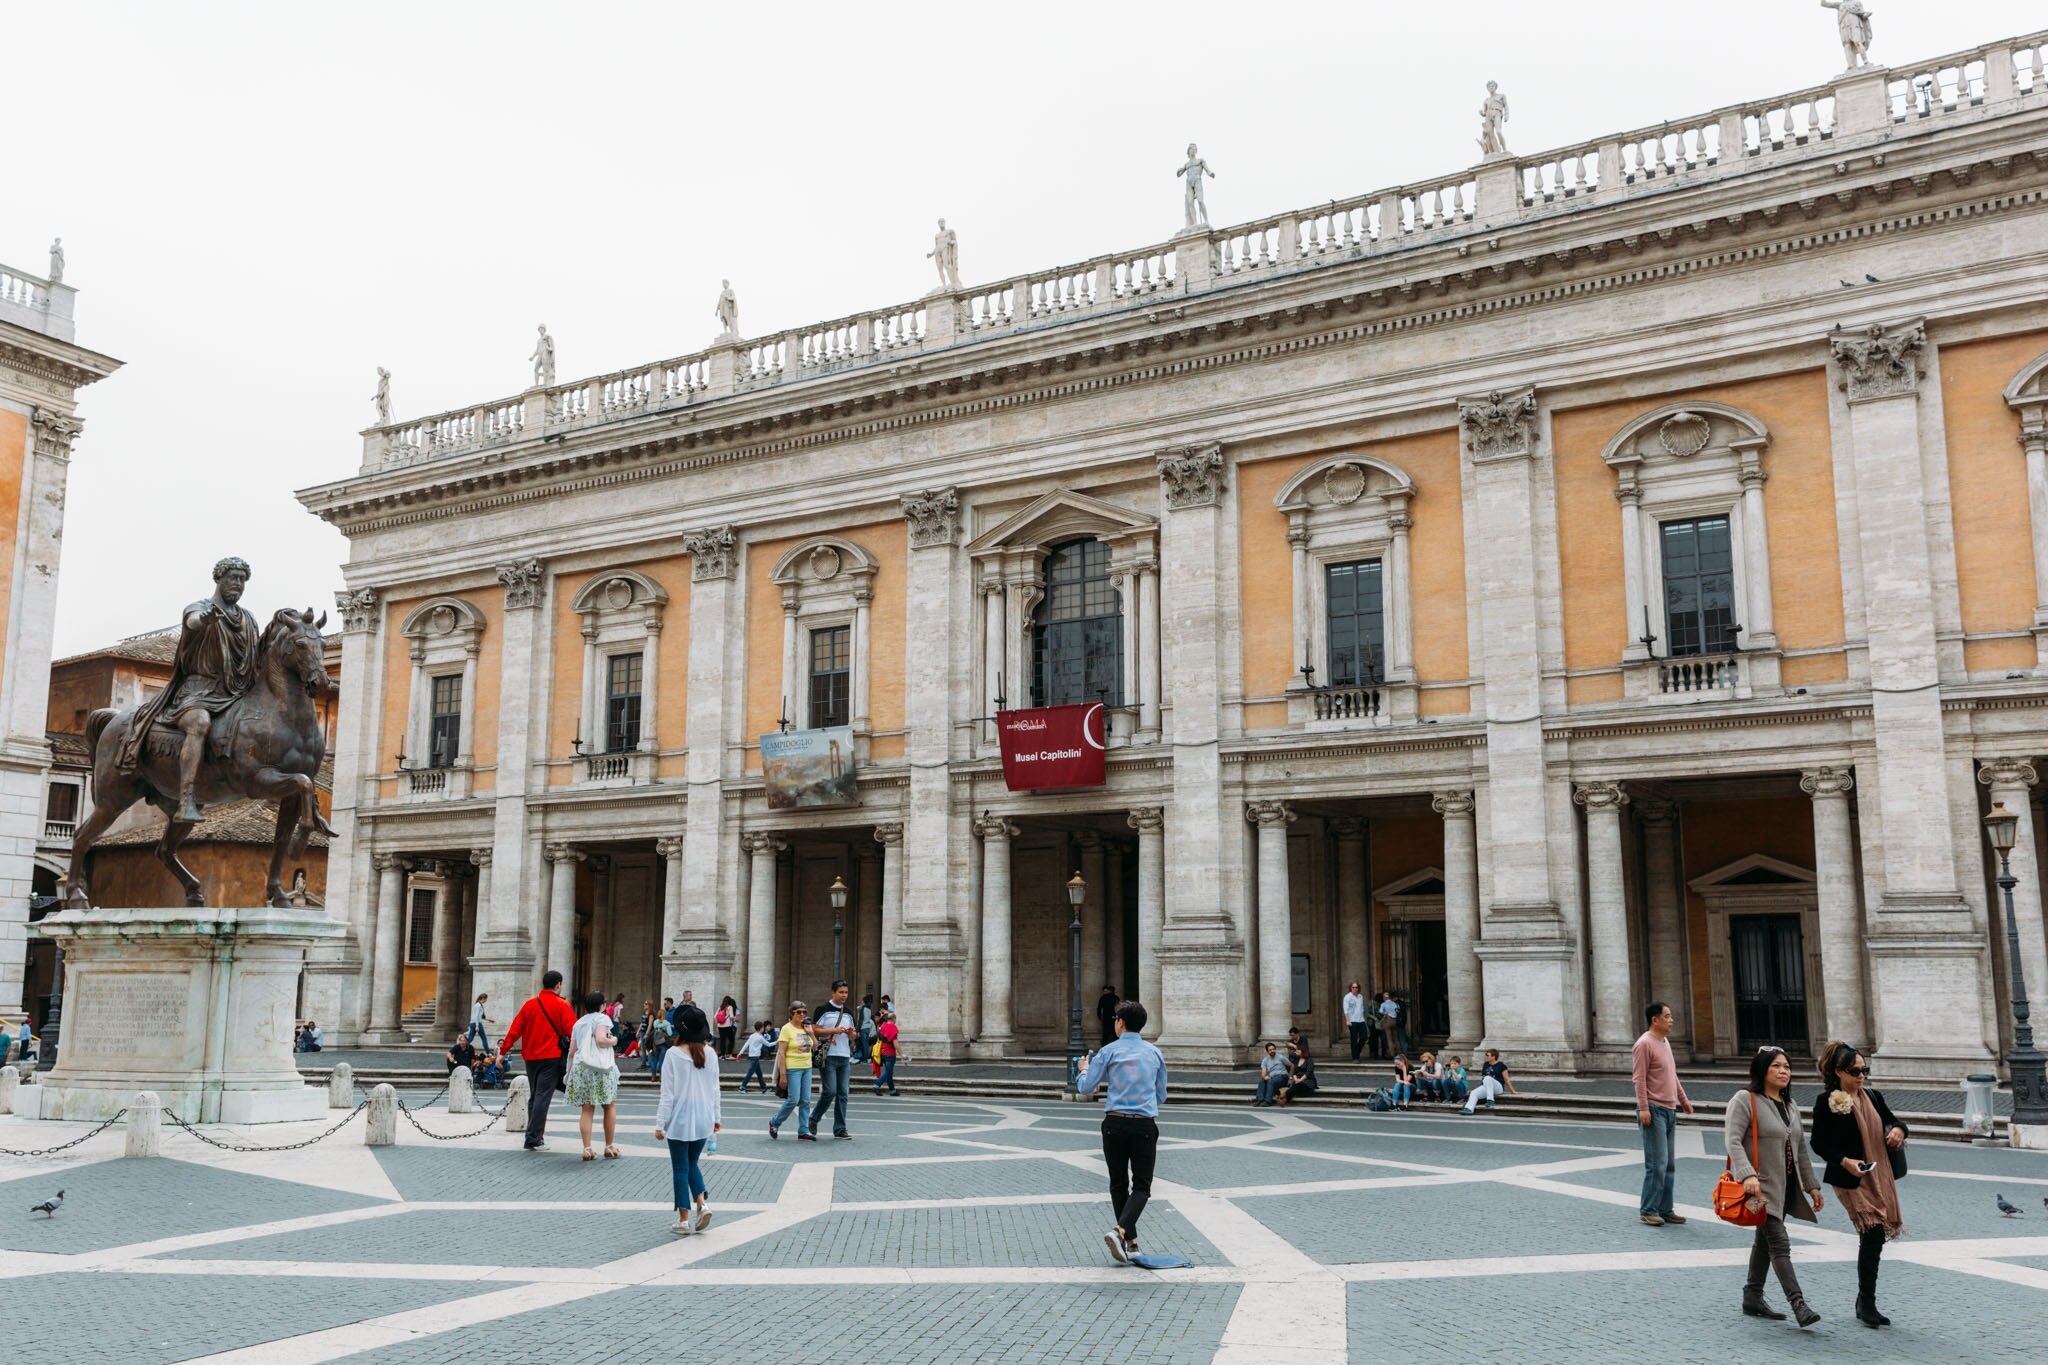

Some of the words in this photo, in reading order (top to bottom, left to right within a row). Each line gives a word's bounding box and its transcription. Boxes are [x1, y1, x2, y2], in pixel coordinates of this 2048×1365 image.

[765, 738, 814, 750] CAMPIDOGLIO
[1015, 752, 1038, 762] Musei
[1040, 748, 1082, 761] Capitolini
